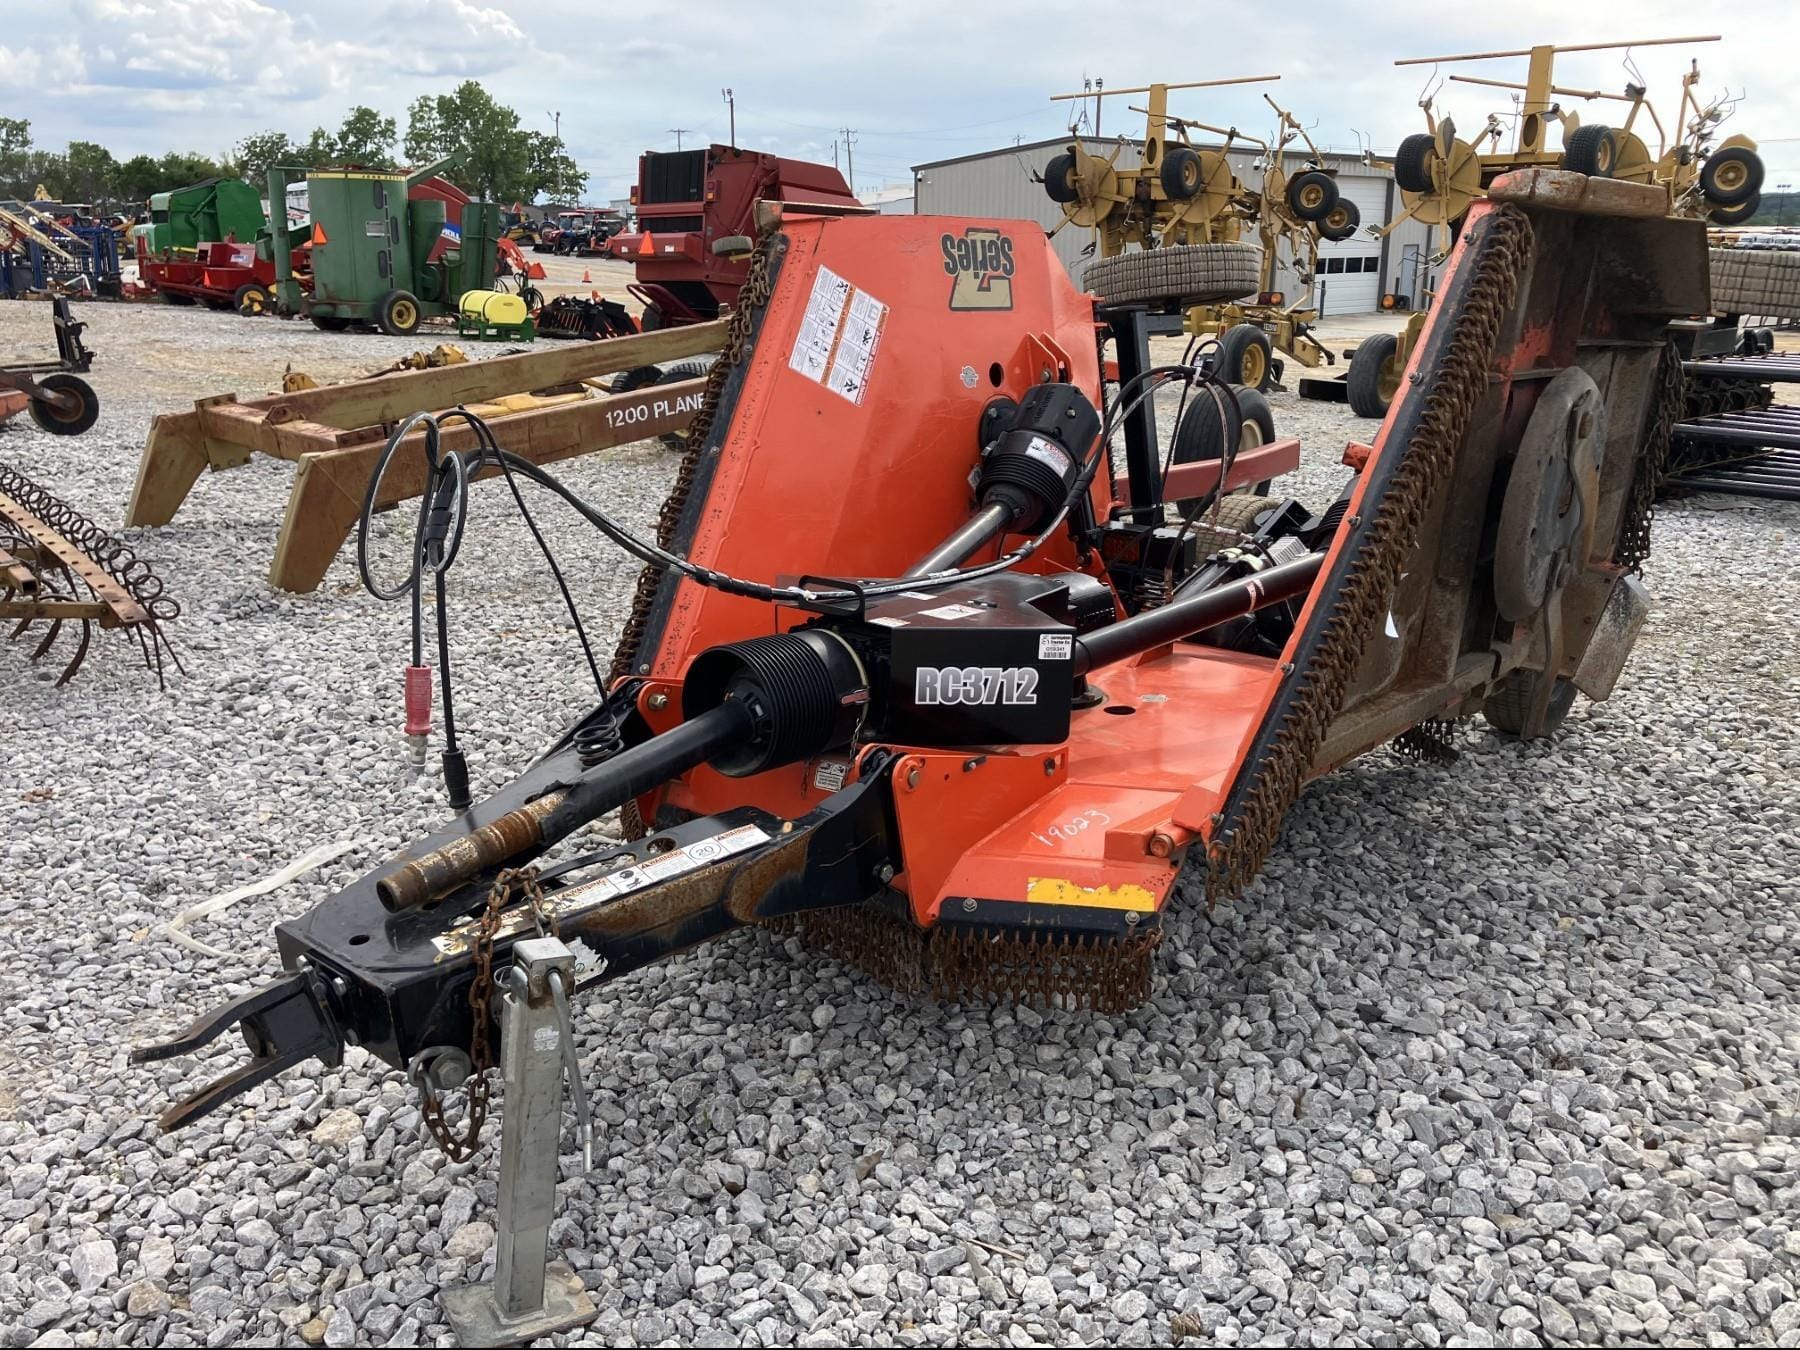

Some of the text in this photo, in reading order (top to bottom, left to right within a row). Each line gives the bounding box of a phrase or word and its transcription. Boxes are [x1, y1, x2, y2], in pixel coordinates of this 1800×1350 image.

[605, 404, 649, 428] 1200
[915, 666, 1039, 705] RC3712
[1029, 809, 1111, 847] 19023
